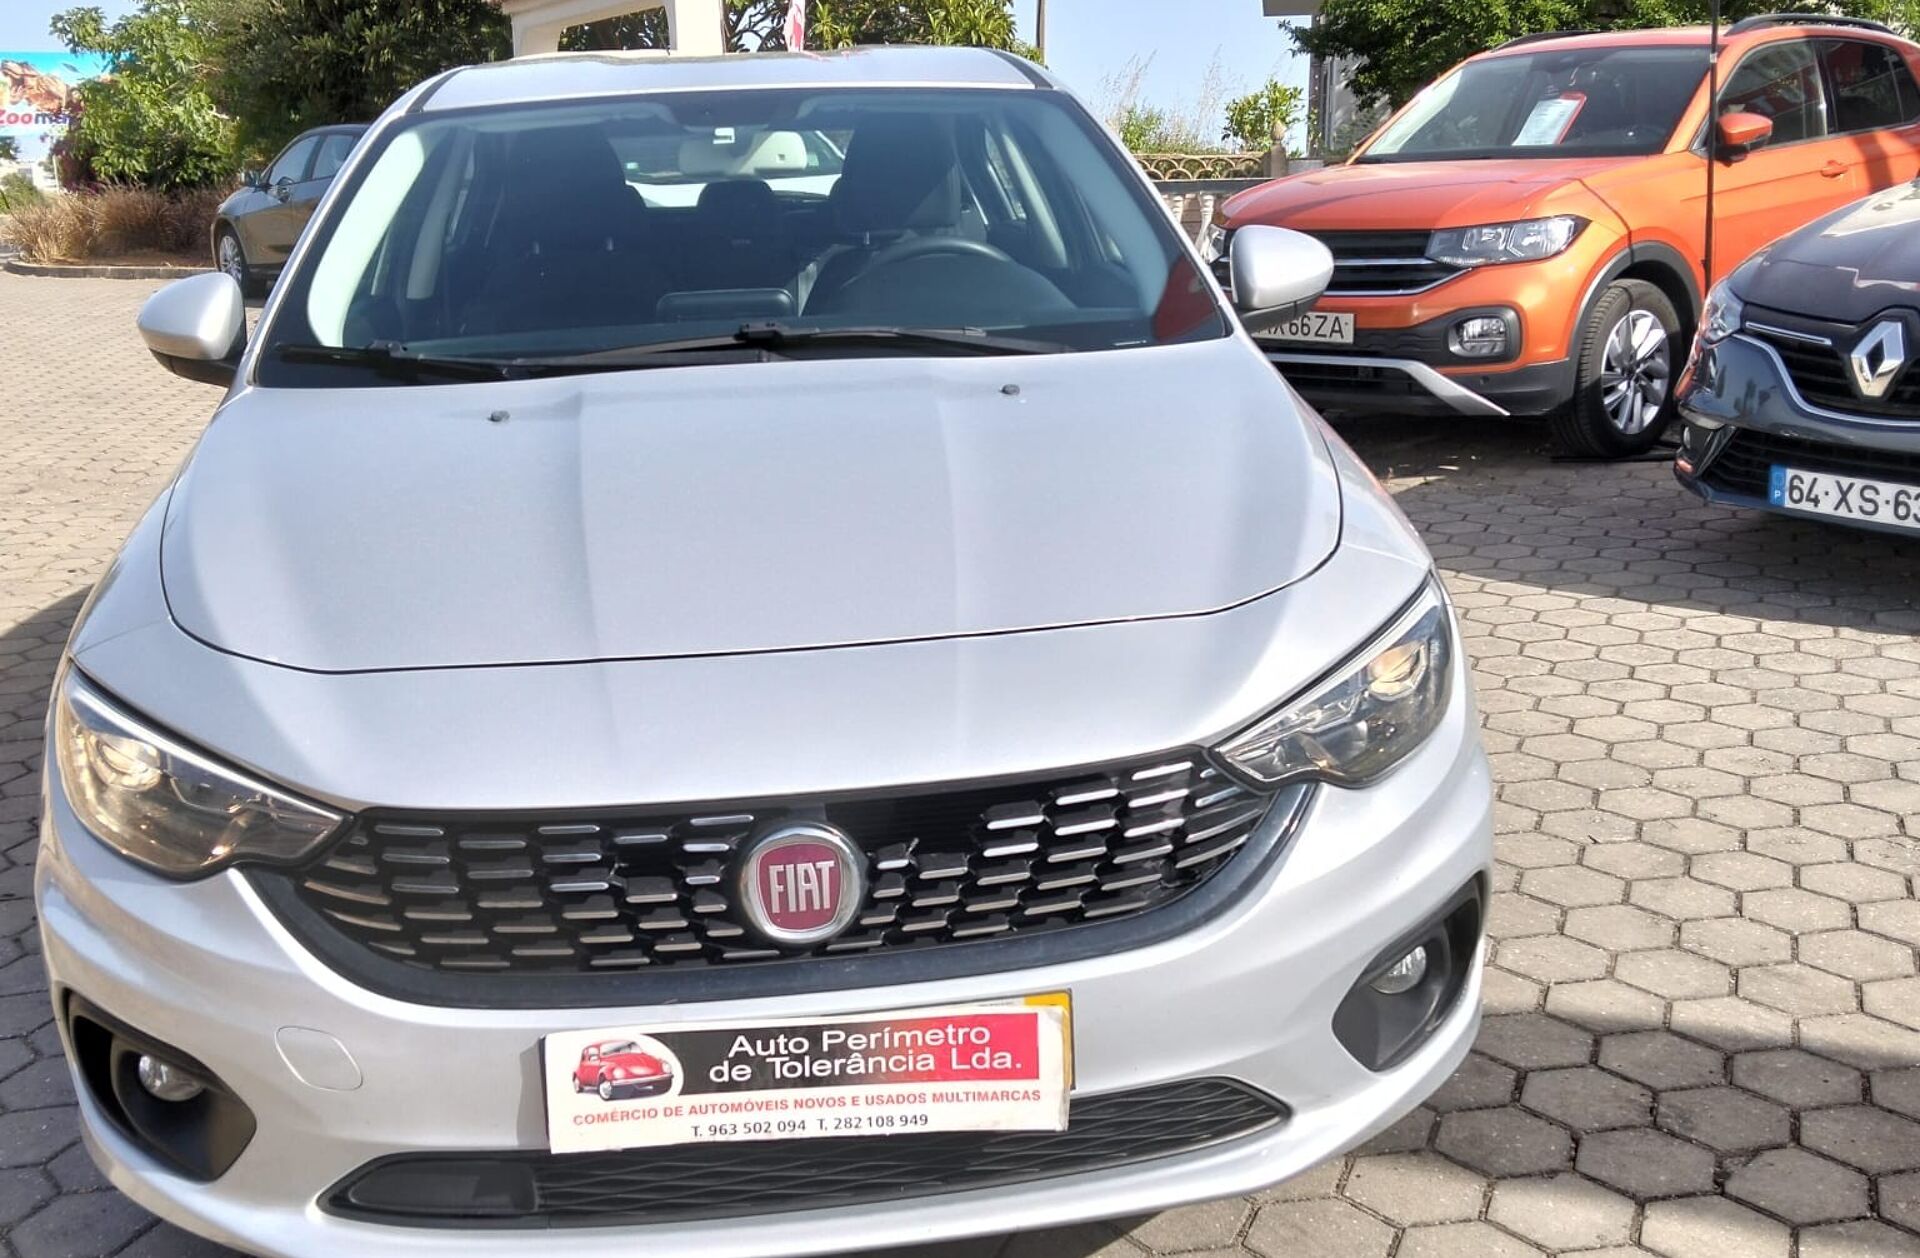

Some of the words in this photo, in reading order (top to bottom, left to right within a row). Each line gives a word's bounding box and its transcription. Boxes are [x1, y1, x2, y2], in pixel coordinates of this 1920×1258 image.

[768, 860, 835, 914] FIAT
[728, 1033, 810, 1059] Auto
[822, 1023, 991, 1052] Perímetro
[709, 1060, 752, 1083] de
[765, 1049, 936, 1079] Tolerância
[951, 1047, 1022, 1070] Lda.
[573, 1107, 658, 1125] COMÉRCIO
[663, 1105, 684, 1118] DE
[688, 1097, 789, 1115] AUTOMÓVEIS
[794, 1096, 846, 1110] NOVOS
[851, 1095, 860, 1106] E
[865, 1092, 927, 1106] USADOS
[932, 1089, 1041, 1104] MULTIMARCAS
[691, 1125, 703, 1137] T.
[708, 1123, 737, 1136] 963
[743, 1121, 772, 1134] 502
[777, 1118, 806, 1132] 094
[816, 1118, 828, 1131] T.
[833, 1116, 862, 1130] 282
[868, 1115, 895, 1129] 108
[899, 1113, 929, 1127] 949
